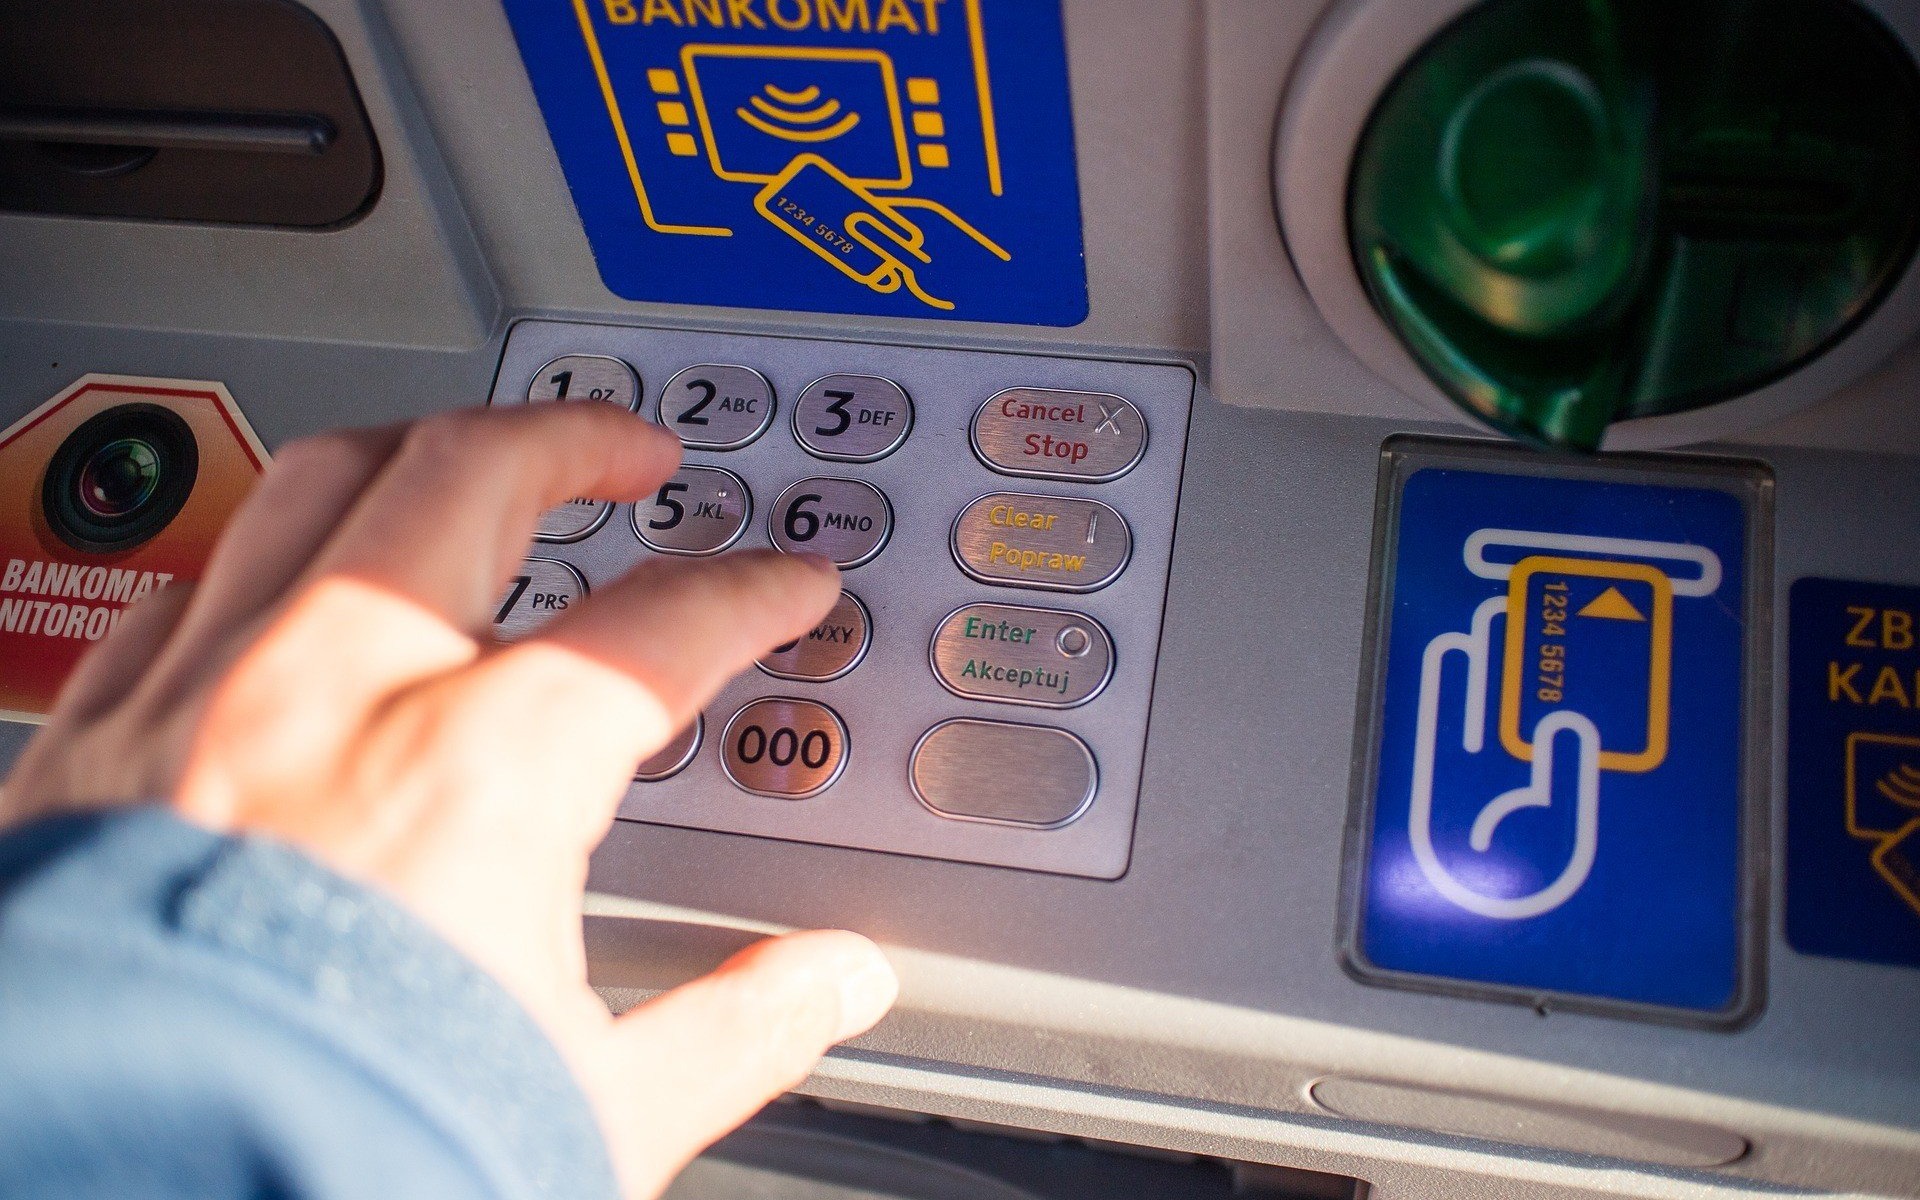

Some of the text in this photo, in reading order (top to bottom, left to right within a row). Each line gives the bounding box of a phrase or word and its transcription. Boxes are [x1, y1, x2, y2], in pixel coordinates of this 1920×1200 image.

[605, 0, 946, 35] BANKOMAT
[777, 197, 854, 253] 1234 5678
[550, 371, 572, 402] 1
[677, 379, 758, 425] 2 ABC
[814, 390, 896, 436] 3 DEF
[1001, 399, 1085, 423] Cancel
[1023, 434, 1089, 464] Stop
[648, 482, 725, 530] 5 JKL
[784, 494, 873, 541] 6 MNO
[989, 506, 1058, 530] Clear
[989, 542, 1086, 571] Popraw
[493, 576, 569, 623] 7 PRS
[808, 624, 854, 643] WXY
[965, 616, 1037, 644] Enter
[1537, 581, 1568, 702] 1234 5678
[962, 658, 1070, 694] Akceptuj
[1828, 661, 1920, 708] KA
[737, 725, 830, 769] 000
